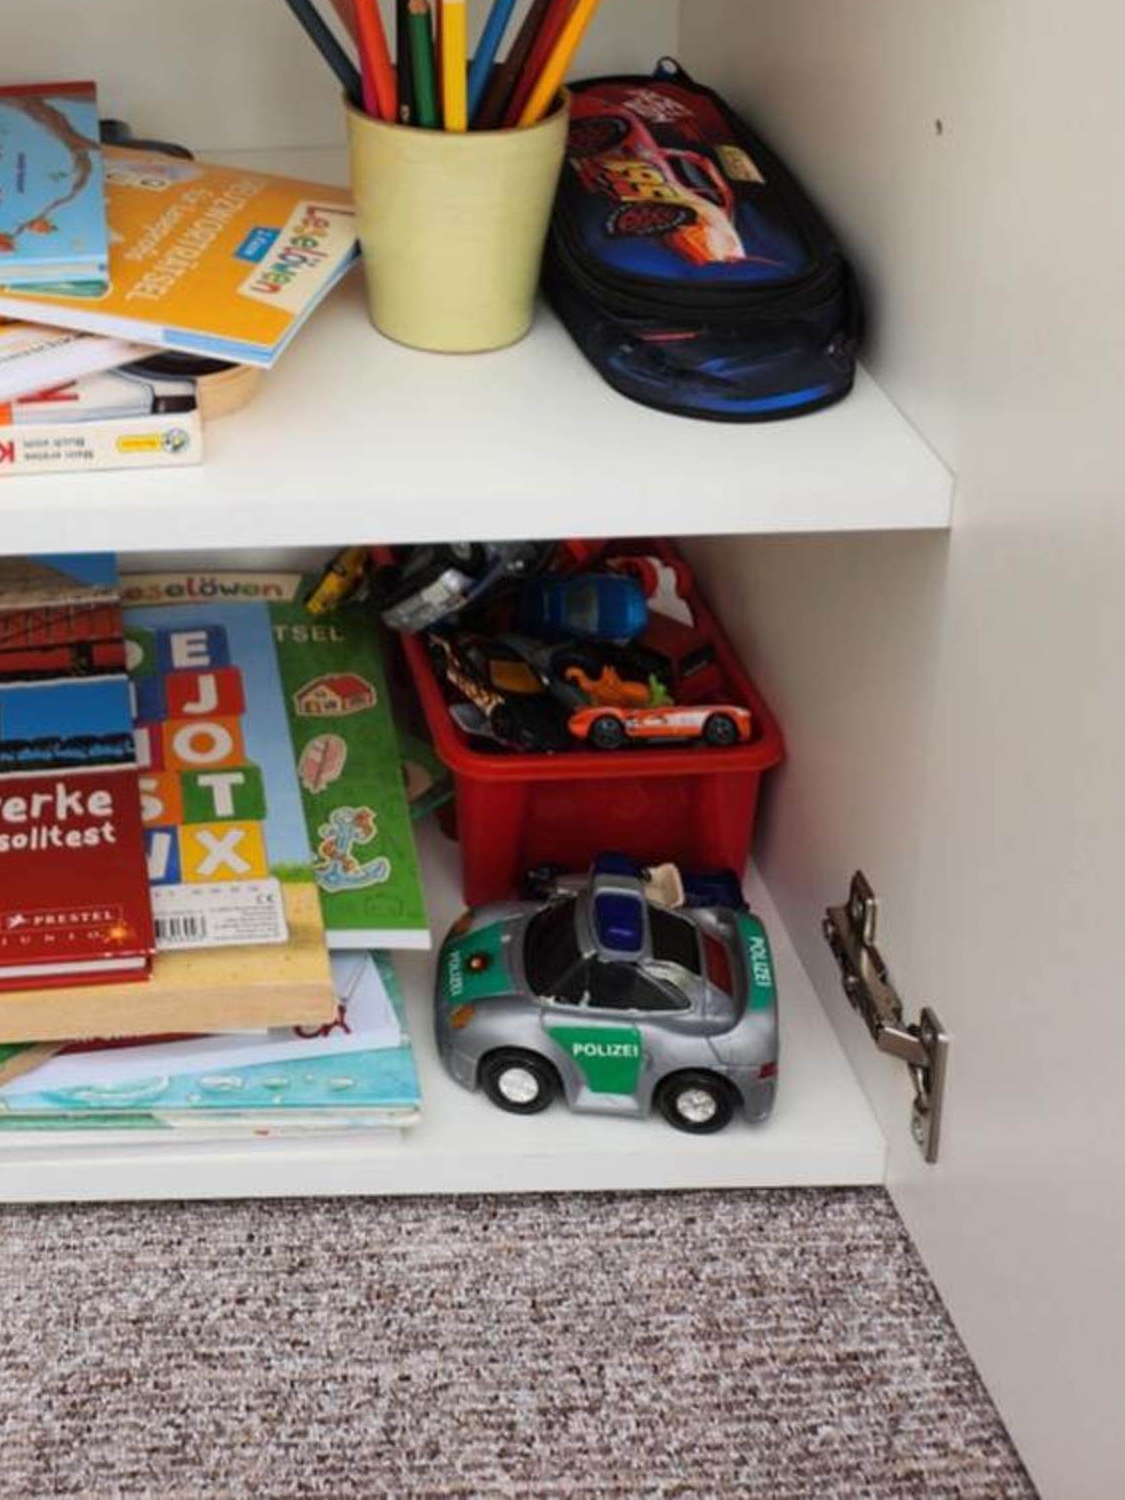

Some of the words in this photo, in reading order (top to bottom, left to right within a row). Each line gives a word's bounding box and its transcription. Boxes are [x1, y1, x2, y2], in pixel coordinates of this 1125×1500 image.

[122, 575, 284, 600] eselöwen
[169, 630, 211, 669] E
[276, 623, 346, 645] TSEL
[182, 674, 219, 715] J
[173, 722, 234, 764] O
[197, 771, 245, 818] T
[195, 828, 252, 876] X
[32, 909, 114, 927] PRESTEL
[447, 949, 462, 997] POLIZEI
[749, 935, 773, 989] POLIZEI
[572, 1042, 639, 1057] POLIZEI
